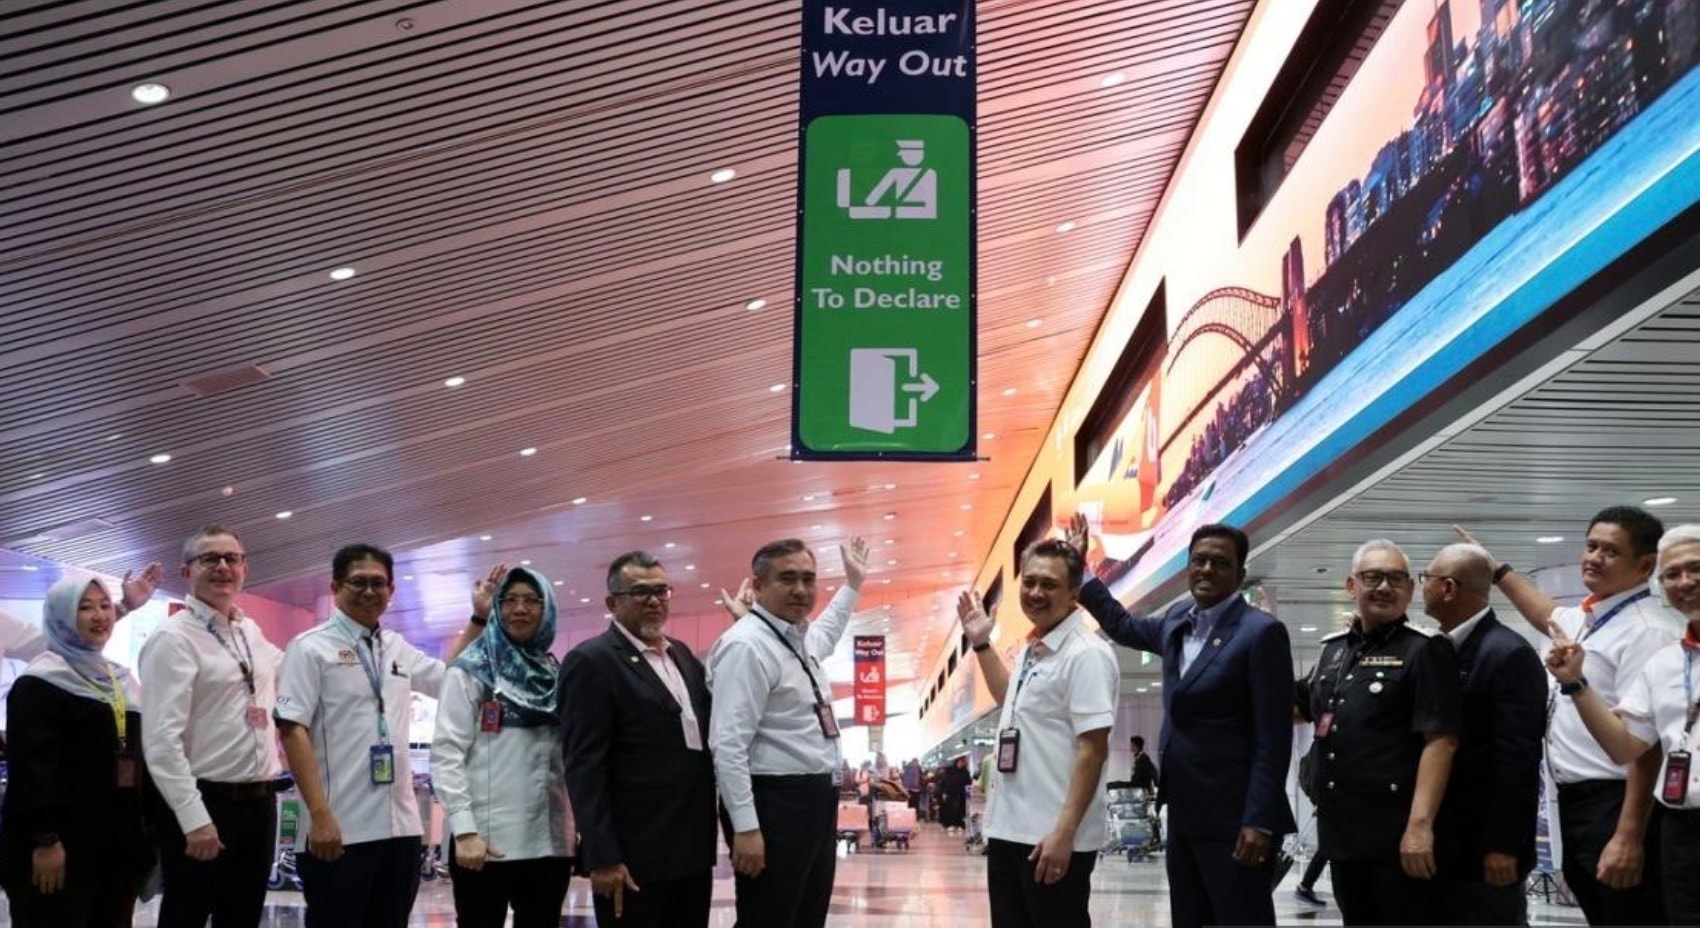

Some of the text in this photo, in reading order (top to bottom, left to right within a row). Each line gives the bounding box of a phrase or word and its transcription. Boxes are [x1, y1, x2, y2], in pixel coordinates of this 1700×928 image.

[824, 7, 956, 35] Keluar
[813, 50, 967, 83] Way Out
[831, 255, 942, 281] Nothing
[812, 287, 961, 309] To Declare
